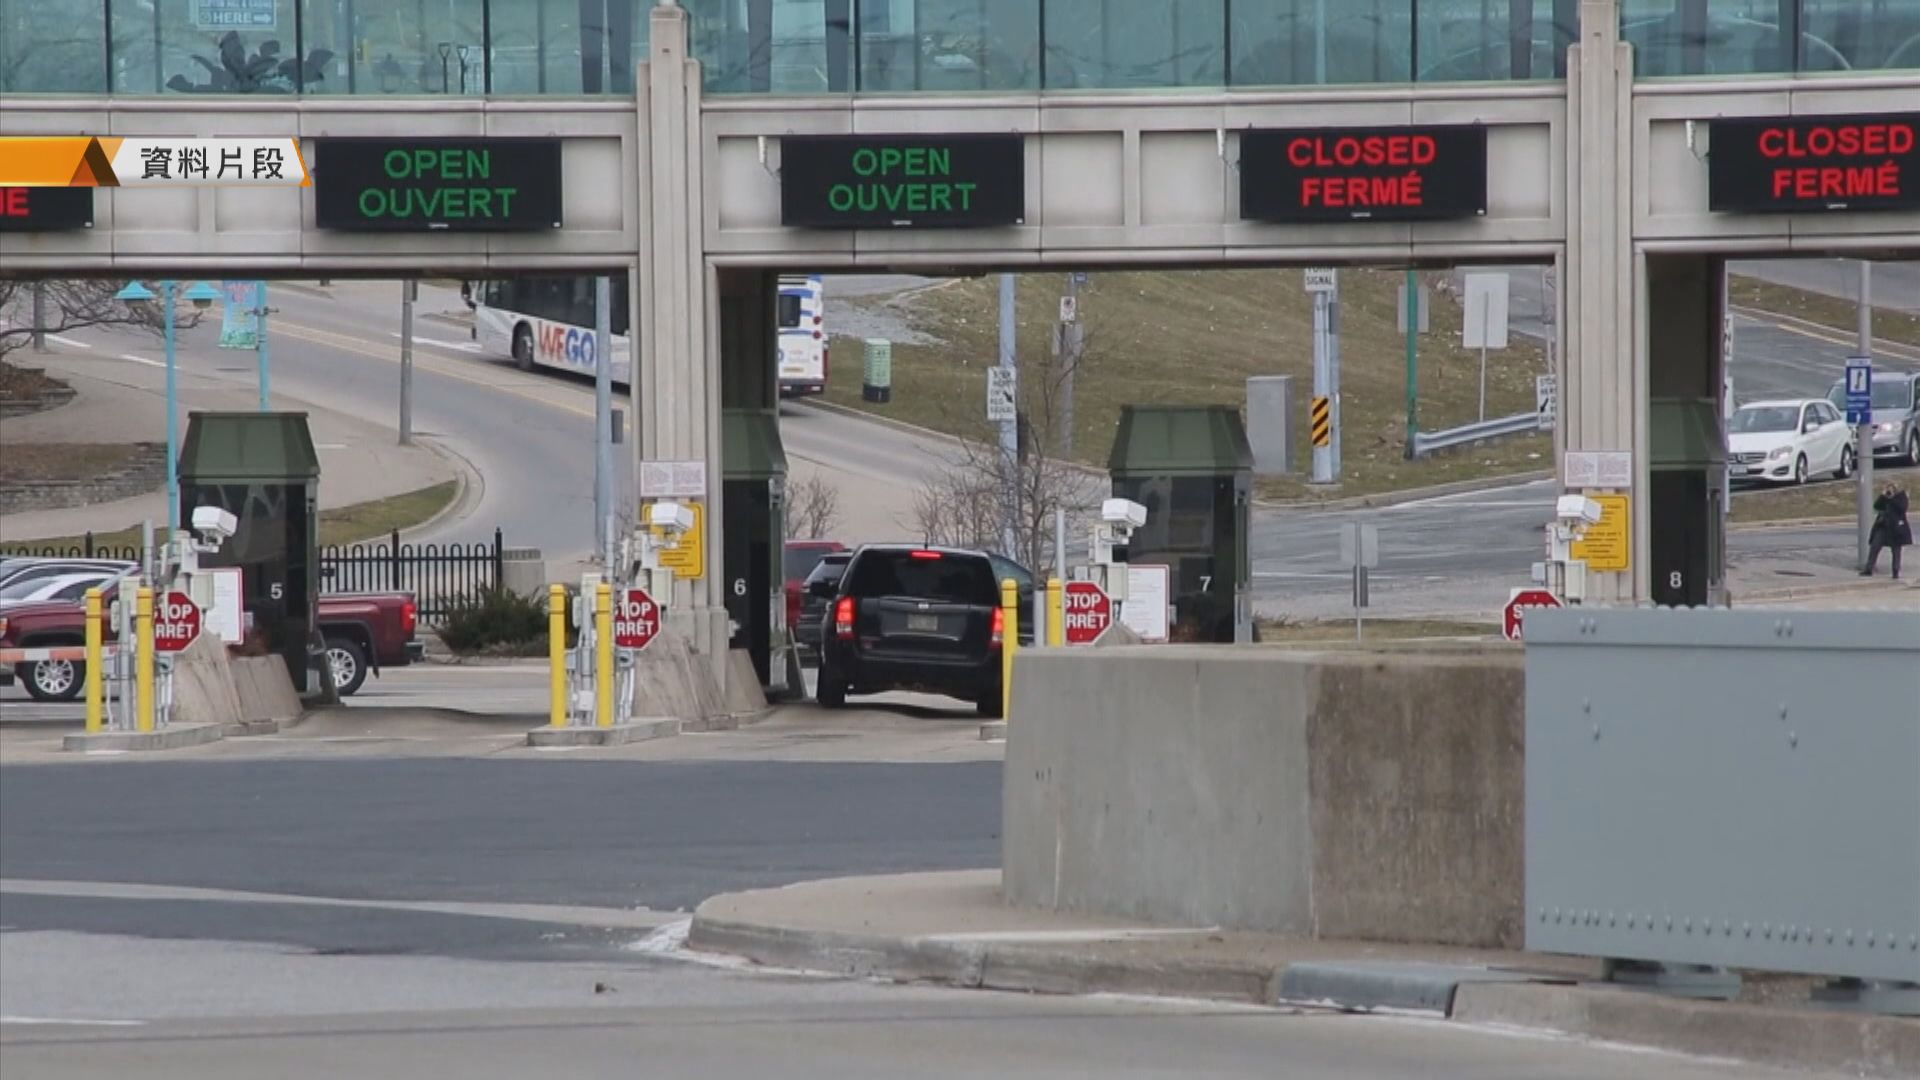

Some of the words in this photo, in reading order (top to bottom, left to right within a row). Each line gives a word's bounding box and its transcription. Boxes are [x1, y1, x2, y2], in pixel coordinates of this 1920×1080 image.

[213, 12, 252, 24] HERE
[1287, 135, 1437, 167] CLOSED
[1758, 124, 1915, 157] CLOSED
[384, 150, 489, 179] OPEN
[852, 147, 950, 176] OPEN
[1301, 171, 1421, 207] FERMÉ
[1772, 160, 1899, 198] FERMÉ
[359, 188, 515, 218] OUVERT
[828, 183, 976, 212] OUVERT
[271, 583, 283, 600] 5
[734, 578, 746, 595] 6
[1200, 576, 1211, 592] 7
[1670, 571, 1682, 588] 8
[155, 620, 194, 639] RRÊT
[616, 618, 653, 636] RRÊT
[1066, 610, 1107, 630] RRÊT
